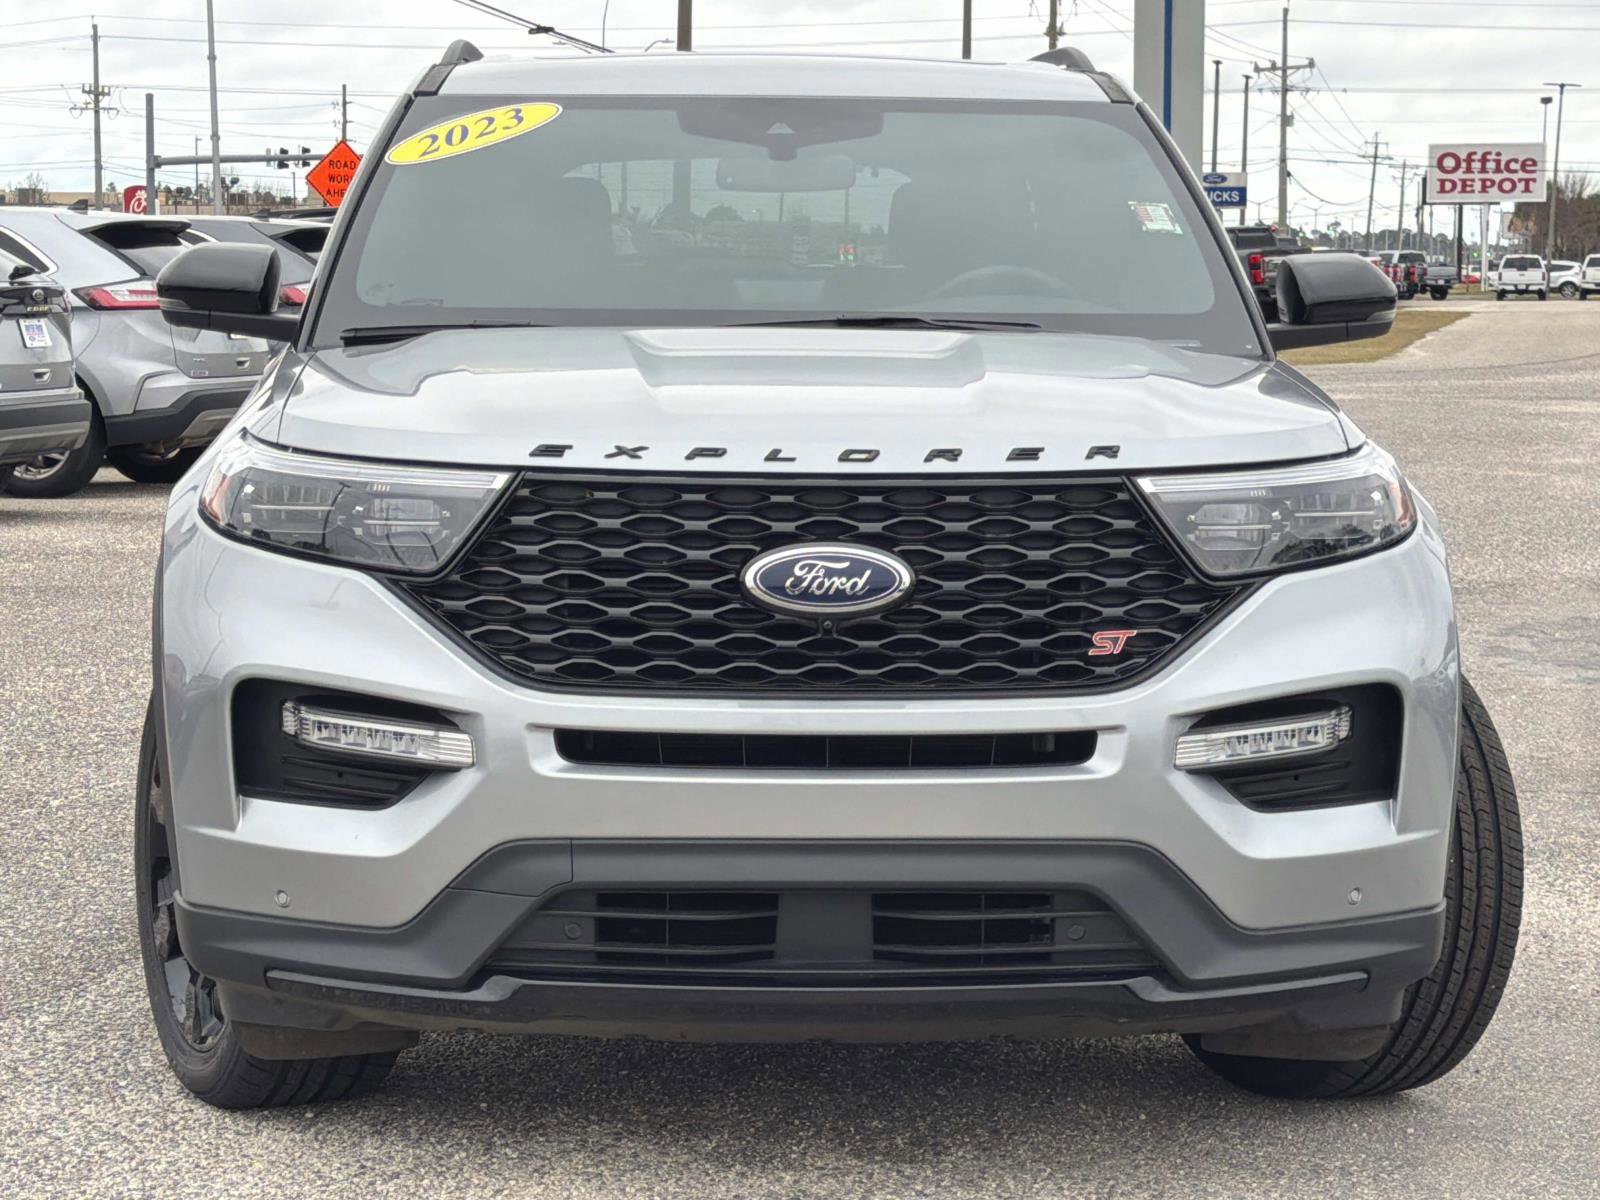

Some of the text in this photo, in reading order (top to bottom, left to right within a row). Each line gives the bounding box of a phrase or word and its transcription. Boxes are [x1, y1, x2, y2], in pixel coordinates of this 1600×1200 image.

[417, 107, 524, 158] 2023
[328, 160, 356, 170] ROAD
[1436, 151, 1538, 175] Office
[328, 174, 352, 184] WOR
[1436, 177, 1537, 194] DEPOT
[326, 189, 346, 198] AHE
[528, 443, 1121, 462] EXPLORER
[784, 560, 873, 596] Ford
[1088, 630, 1137, 655] ST
